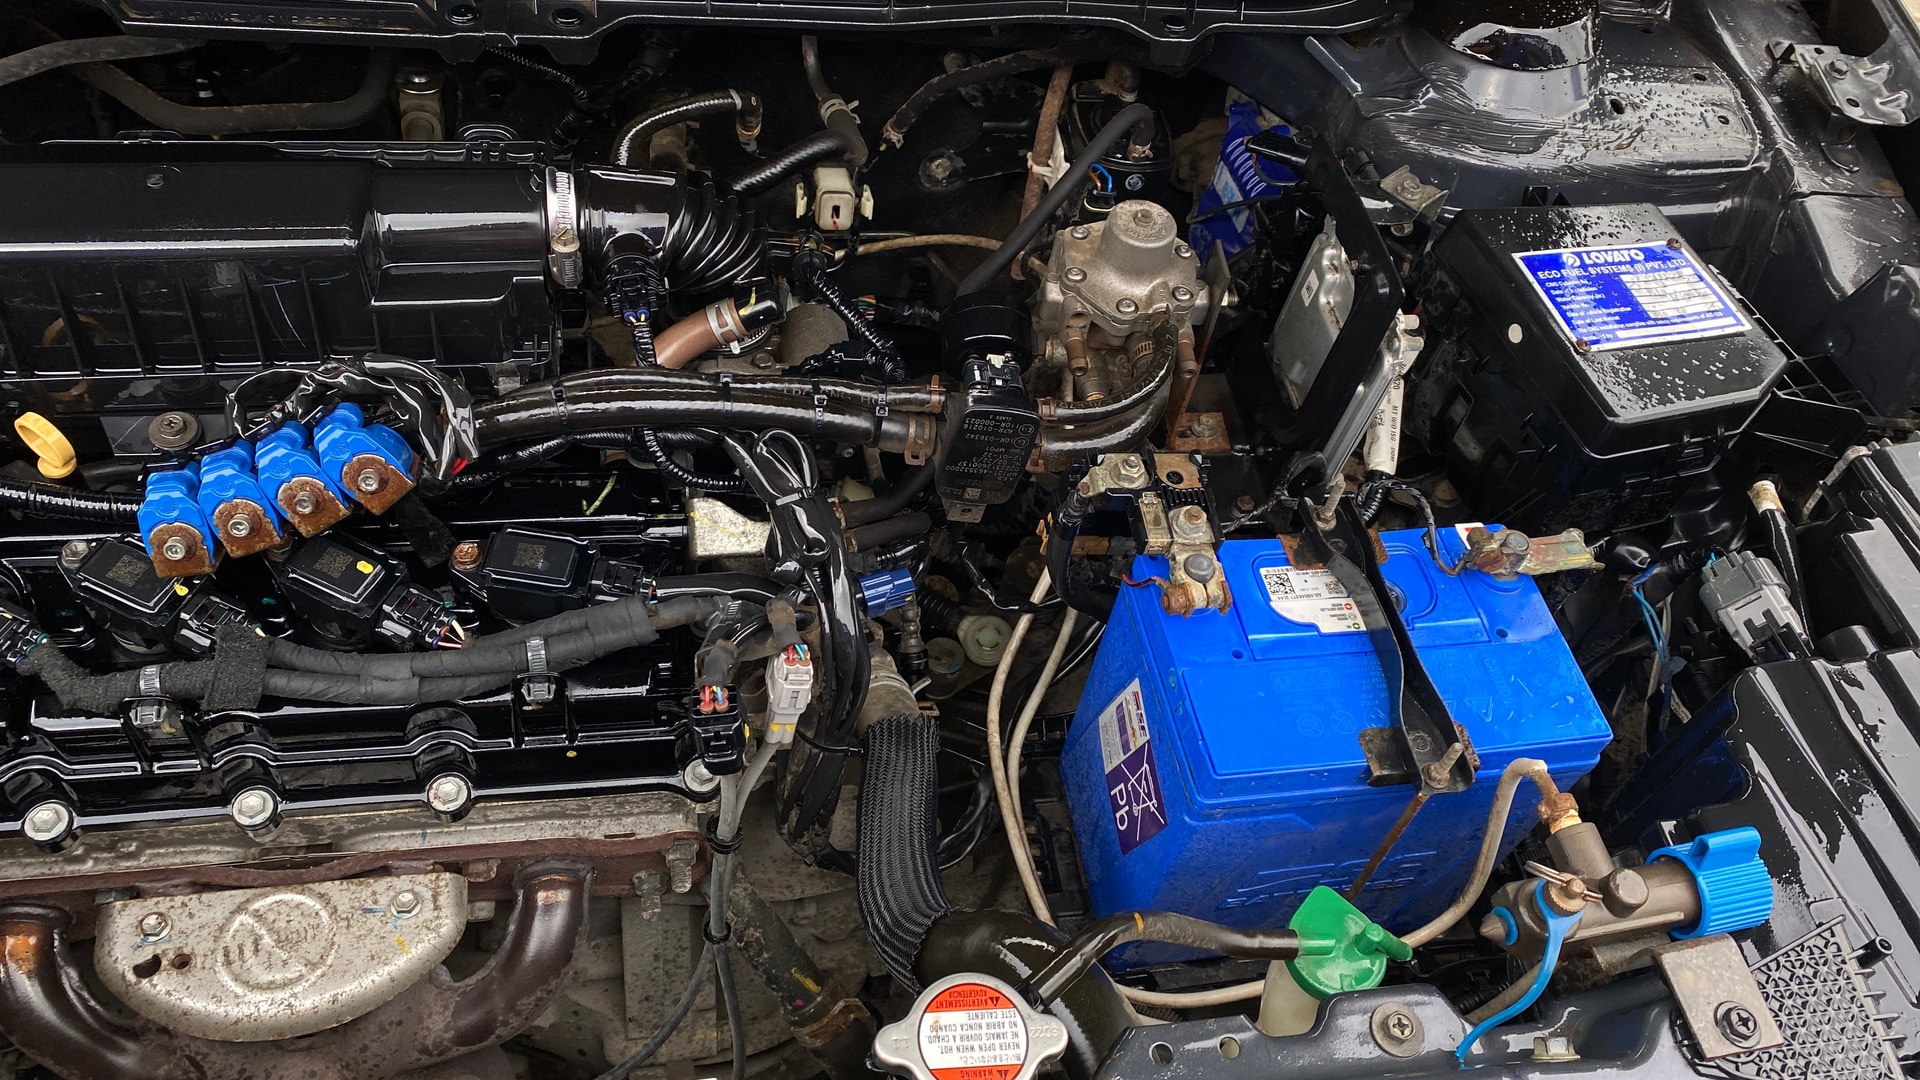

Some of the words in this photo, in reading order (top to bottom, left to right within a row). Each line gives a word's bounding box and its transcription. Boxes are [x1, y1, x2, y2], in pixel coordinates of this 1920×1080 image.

[1584, 249, 1645, 265] LOVATO
[1537, 269, 1561, 280] ECO
[1561, 266, 1589, 277] FUEL
[1590, 263, 1634, 275] SYSTEMS
[1634, 262, 1646, 273] (I)
[1646, 261, 1669, 271] PVT.
[1669, 258, 1690, 268] LTD.
[965, 417, 1019, 429] 110R-000023
[963, 423, 1014, 434] 67R-010216
[965, 433, 1014, 443] 10R-036342
[1111, 783, 1130, 831] Pb
[948, 989, 987, 999] ADVERTENCIA
[935, 998, 988, 1009] AVERTISSEMENT
[965, 1010, 998, 1021] CALIENTE.
[1001, 1009, 1016, 1018] ESTE
[929, 1023, 957, 1033] CUANDO
[960, 1023, 983, 1031] NUNCA
[986, 1021, 1005, 1030] ABRIR
[1008, 1020, 1018, 1029] NO
[960, 1033, 983, 1043] OUVRIR
[985, 1031, 1008, 1041] JAMAIS
[1011, 1031, 1019, 1039] NE
[938, 1045, 954, 1055] HOT.
[956, 1044, 976, 1054] WHEN
[978, 1043, 996, 1052] OPEN
[999, 1041, 1020, 1051] NEVER
[960, 1068, 993, 1078] WARNING
